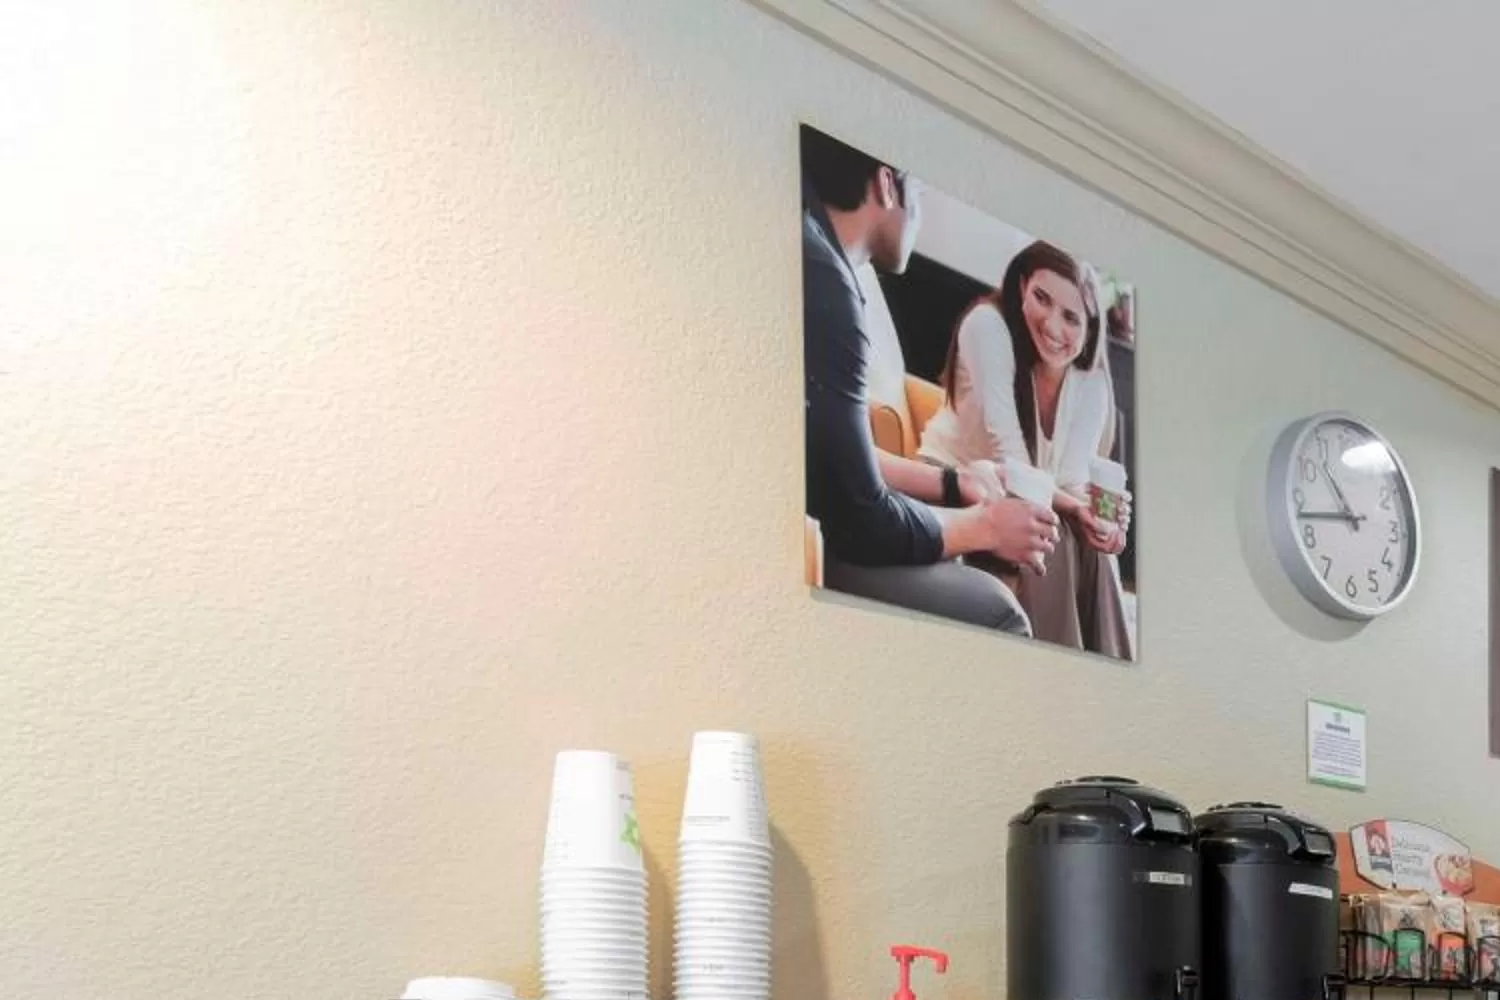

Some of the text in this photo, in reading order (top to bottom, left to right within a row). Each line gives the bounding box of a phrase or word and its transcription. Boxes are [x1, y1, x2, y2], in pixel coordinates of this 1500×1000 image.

[1303, 524, 1316, 549] 8
[1388, 520, 1399, 544] 3
[1320, 555, 1332, 580] 7
[1381, 547, 1393, 572] 4
[1345, 574, 1357, 598] 6
[1367, 569, 1379, 592] 5
